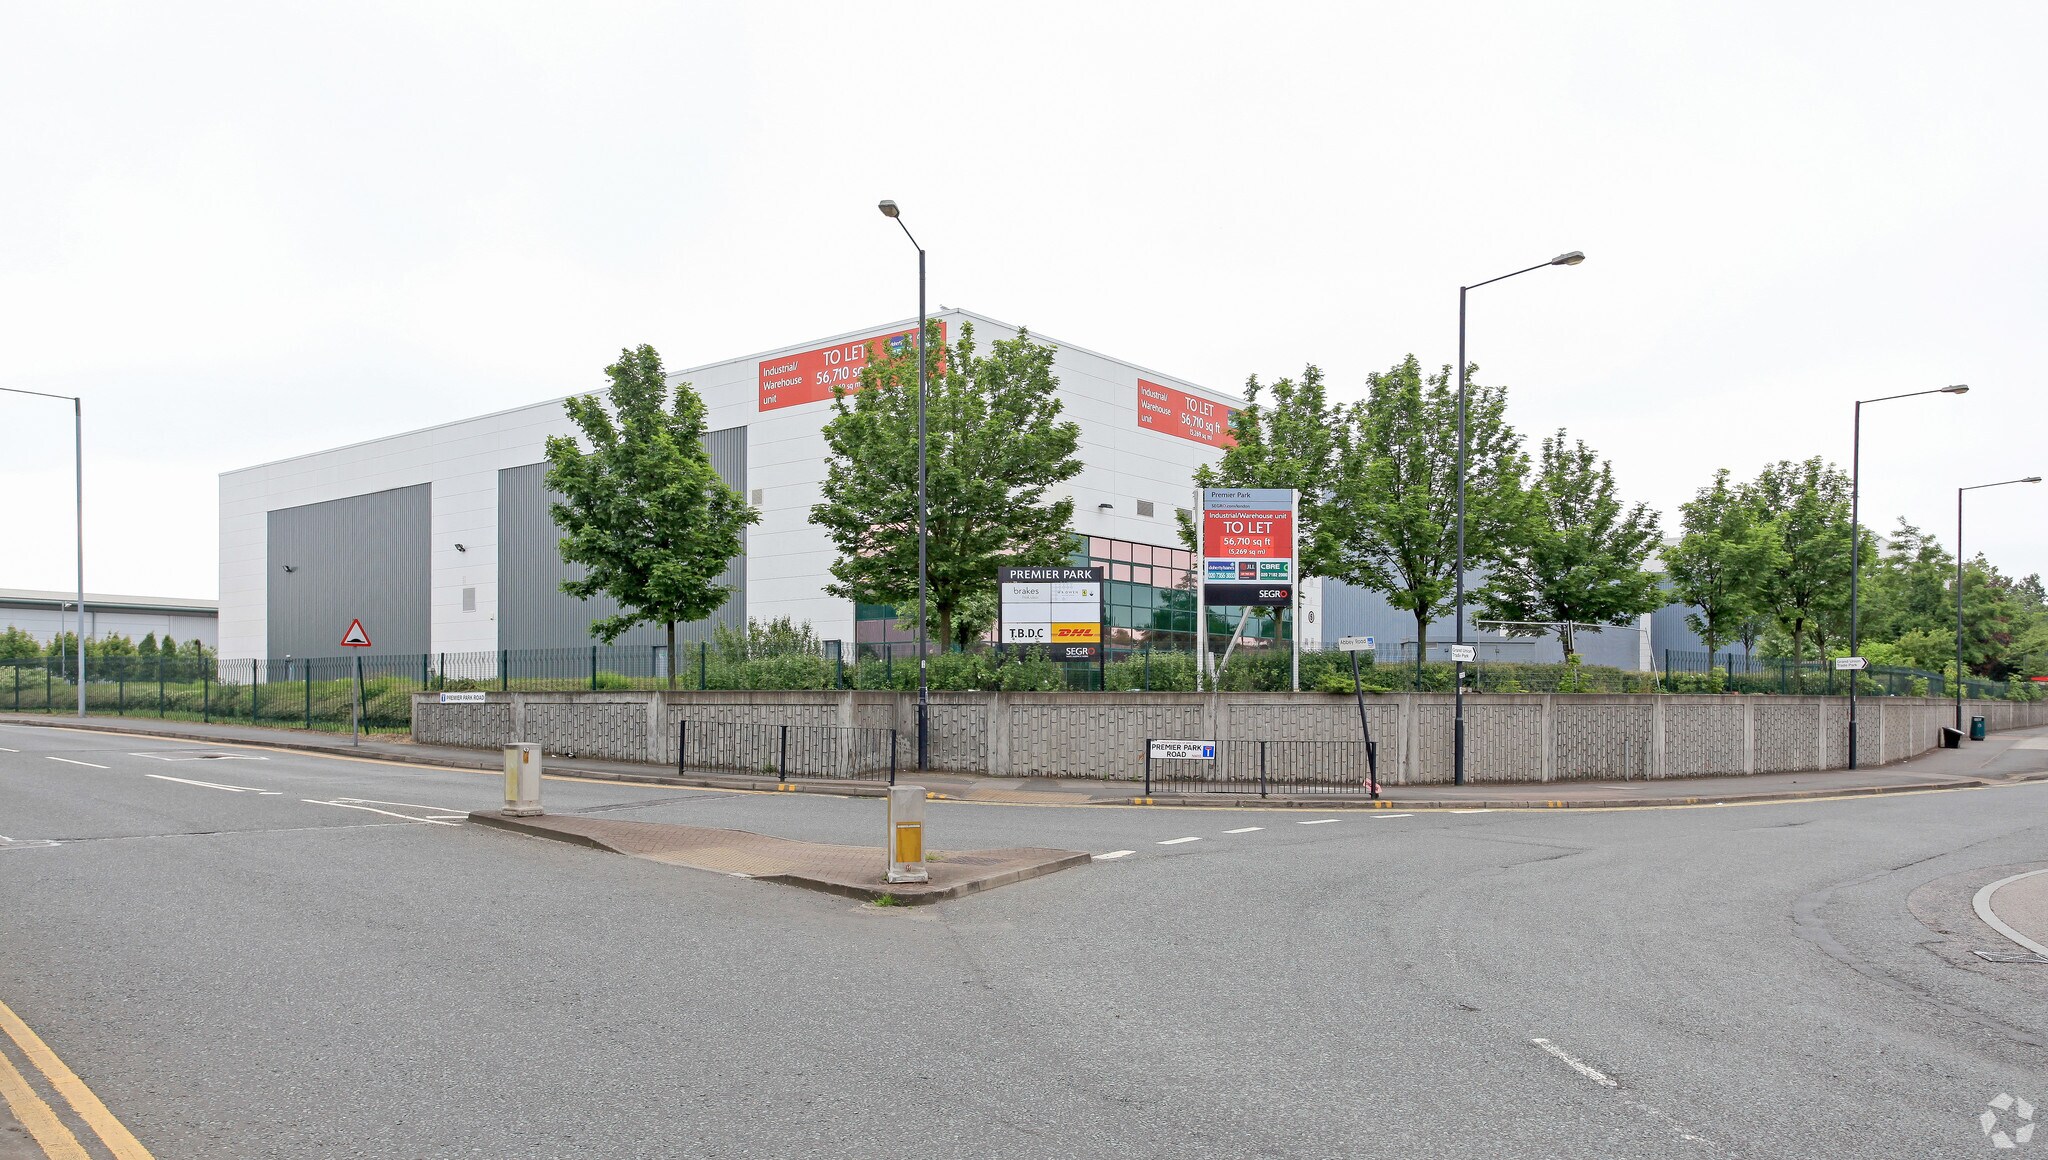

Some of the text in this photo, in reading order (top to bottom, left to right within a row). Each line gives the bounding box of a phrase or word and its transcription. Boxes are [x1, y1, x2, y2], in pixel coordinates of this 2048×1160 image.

[823, 344, 865, 366] TO LET
[764, 361, 798, 377] Industrial/
[816, 366, 849, 384] 56,710
[764, 376, 802, 390] Warehouse
[764, 395, 776, 404] unit
[1141, 386, 1168, 401] Industrial/
[1141, 400, 1171, 416] Warehouse
[1185, 397, 1214, 417] TO LET
[1141, 415, 1152, 424] unit
[1181, 413, 1220, 434] 56,710 sq ft
[1224, 522, 1272, 534] TO LET
[1224, 538, 1250, 546] 56,710
[1010, 570, 1092, 579] PREMIER PARK
[1259, 590, 1287, 598] SEGRO
[1009, 628, 1043, 638] T.B.D.C
[1066, 647, 1095, 655] SEGRO
